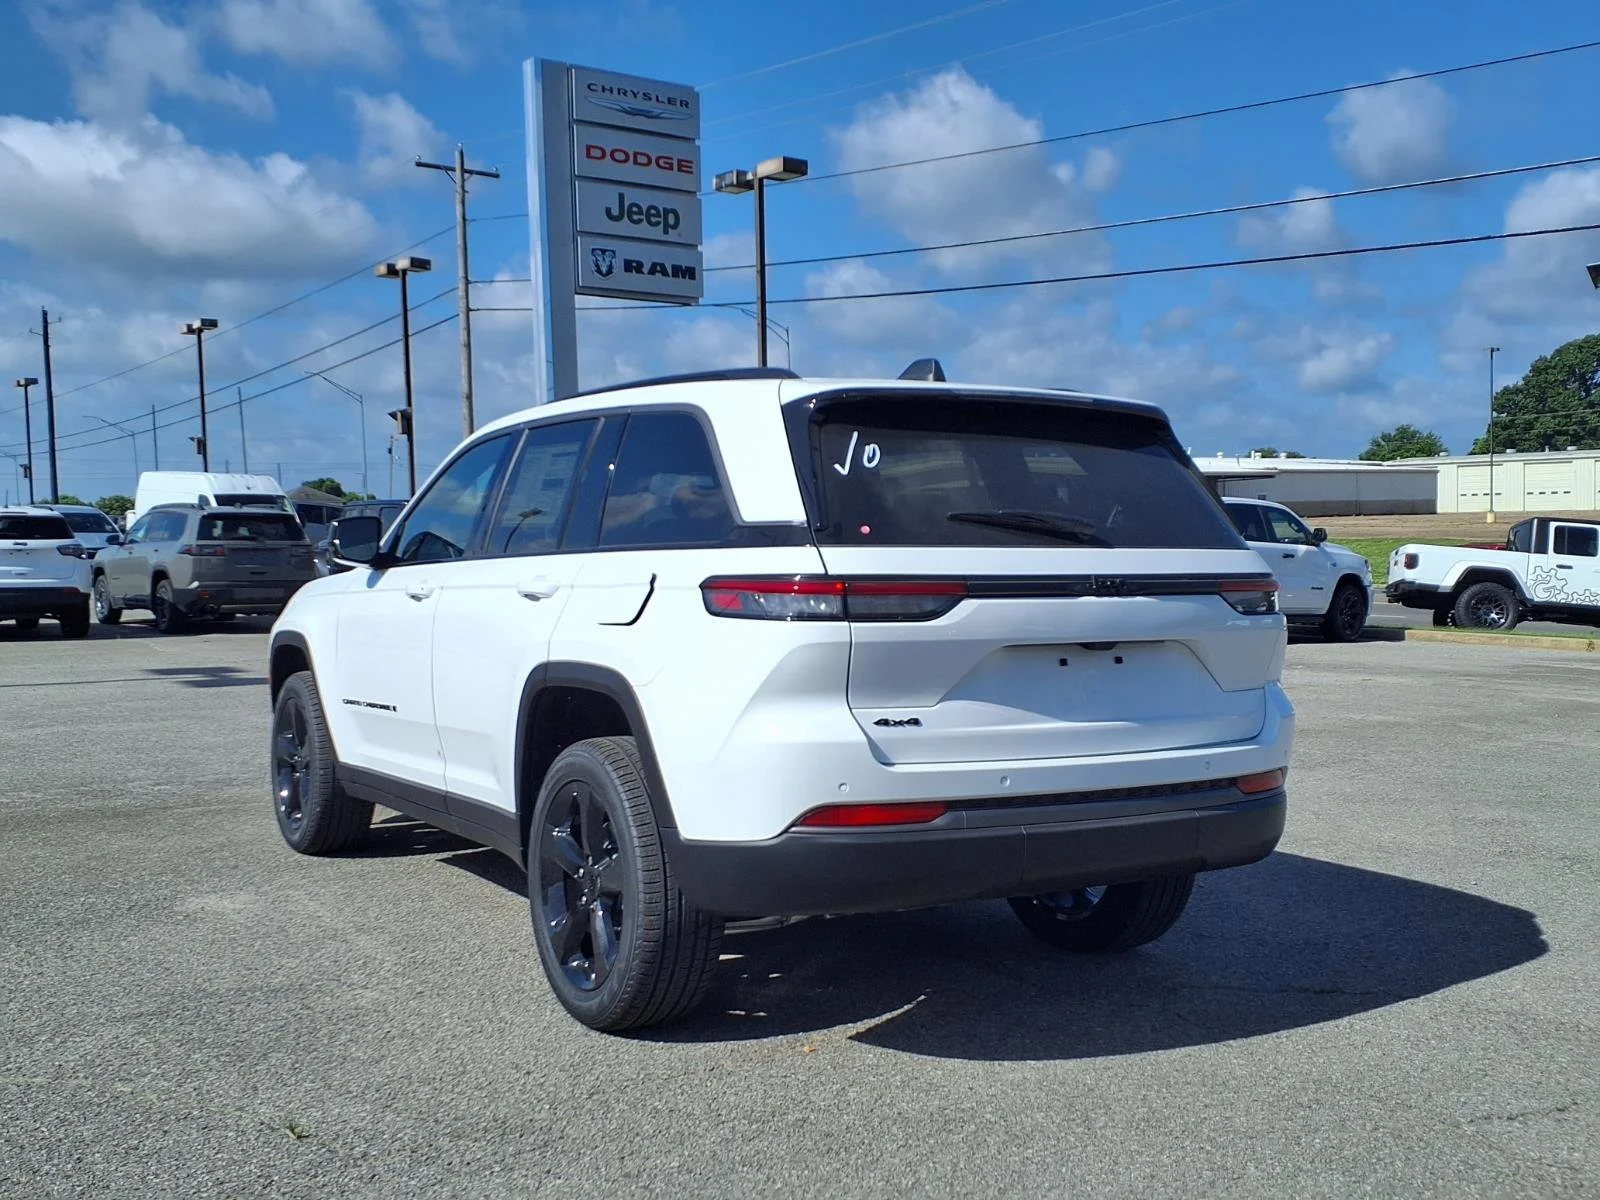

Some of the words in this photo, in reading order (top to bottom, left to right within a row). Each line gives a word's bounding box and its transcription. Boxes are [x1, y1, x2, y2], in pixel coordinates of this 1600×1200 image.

[587, 82, 690, 109] CHRYSLER
[585, 144, 694, 174] DODGE
[605, 192, 681, 234] Jeep
[623, 258, 696, 281] RAM
